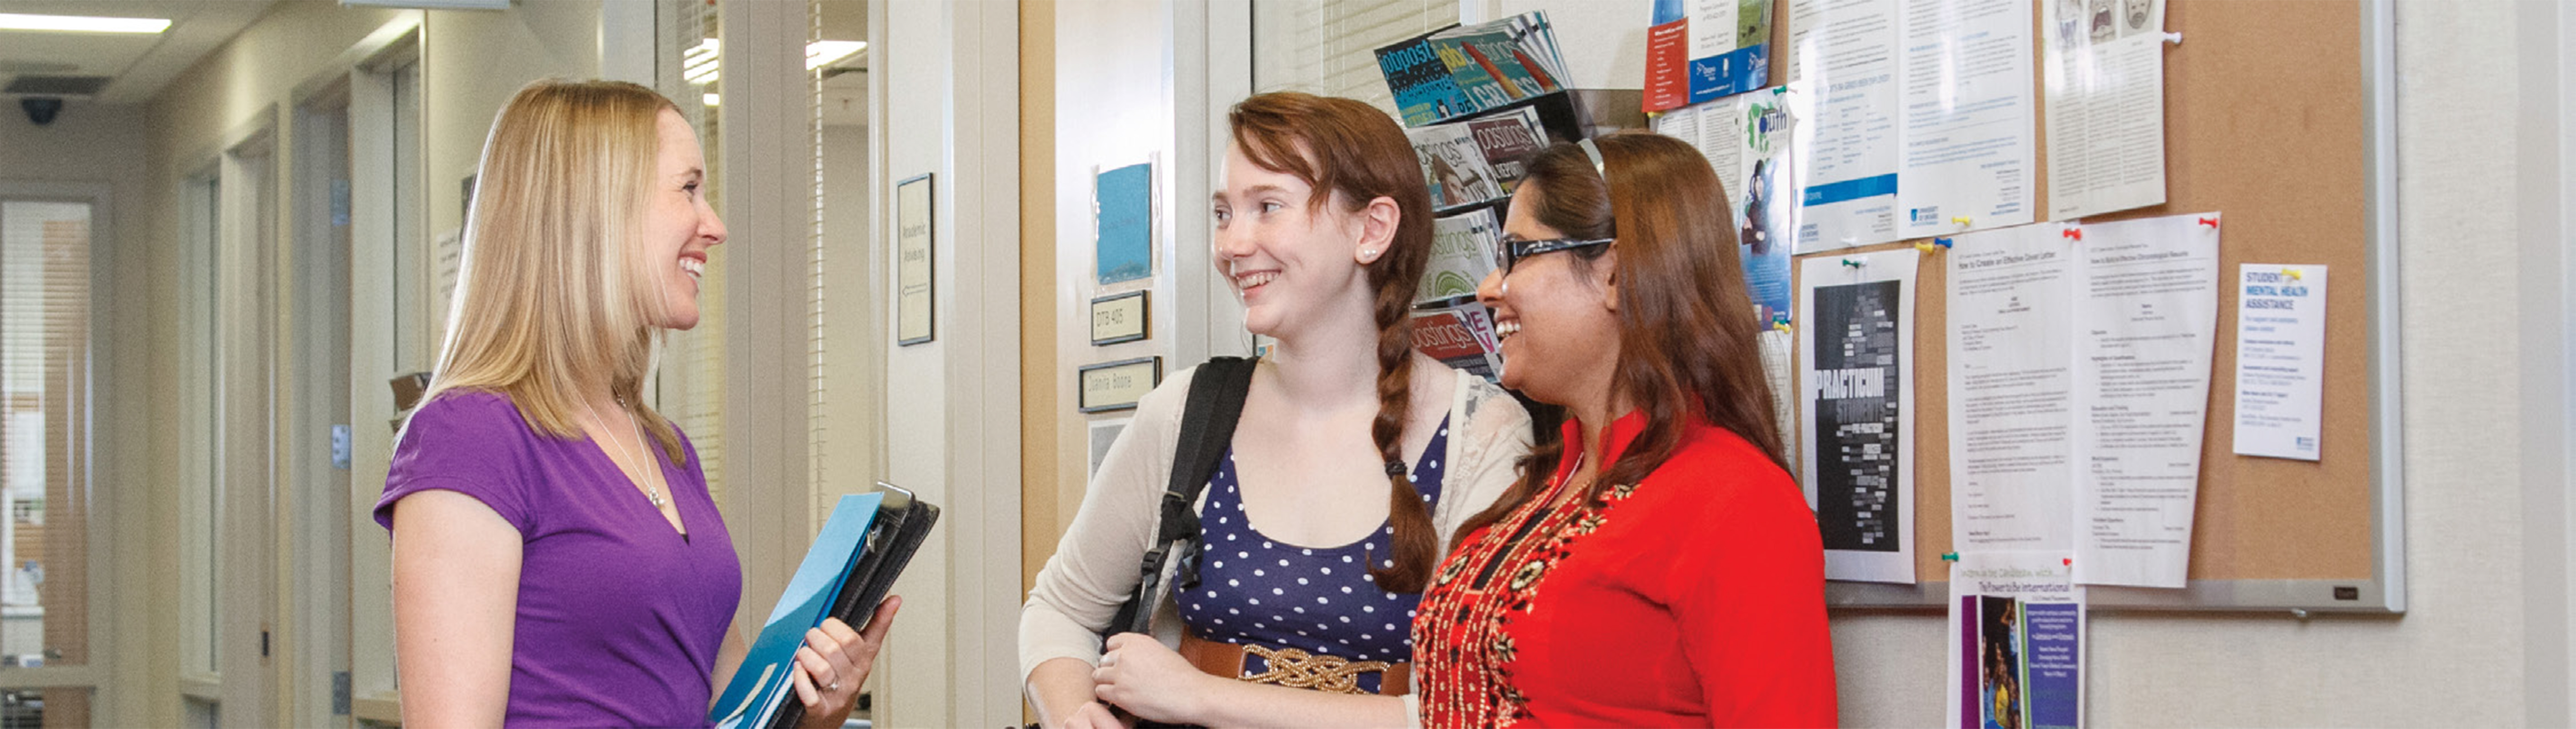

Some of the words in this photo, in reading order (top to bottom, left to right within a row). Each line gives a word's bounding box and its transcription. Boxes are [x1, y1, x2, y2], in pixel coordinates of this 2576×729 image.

[1478, 120, 1534, 158] postings
[1977, 259, 1994, 267] Create
[2003, 255, 2024, 264] Effective
[2041, 251, 2056, 260] Letter
[2281, 286, 2308, 297] HEALTH
[1096, 311, 1110, 327] DTB
[1111, 308, 1123, 325] 405
[1813, 368, 1884, 400] PRACTICUM
[2021, 581, 2070, 592] International
